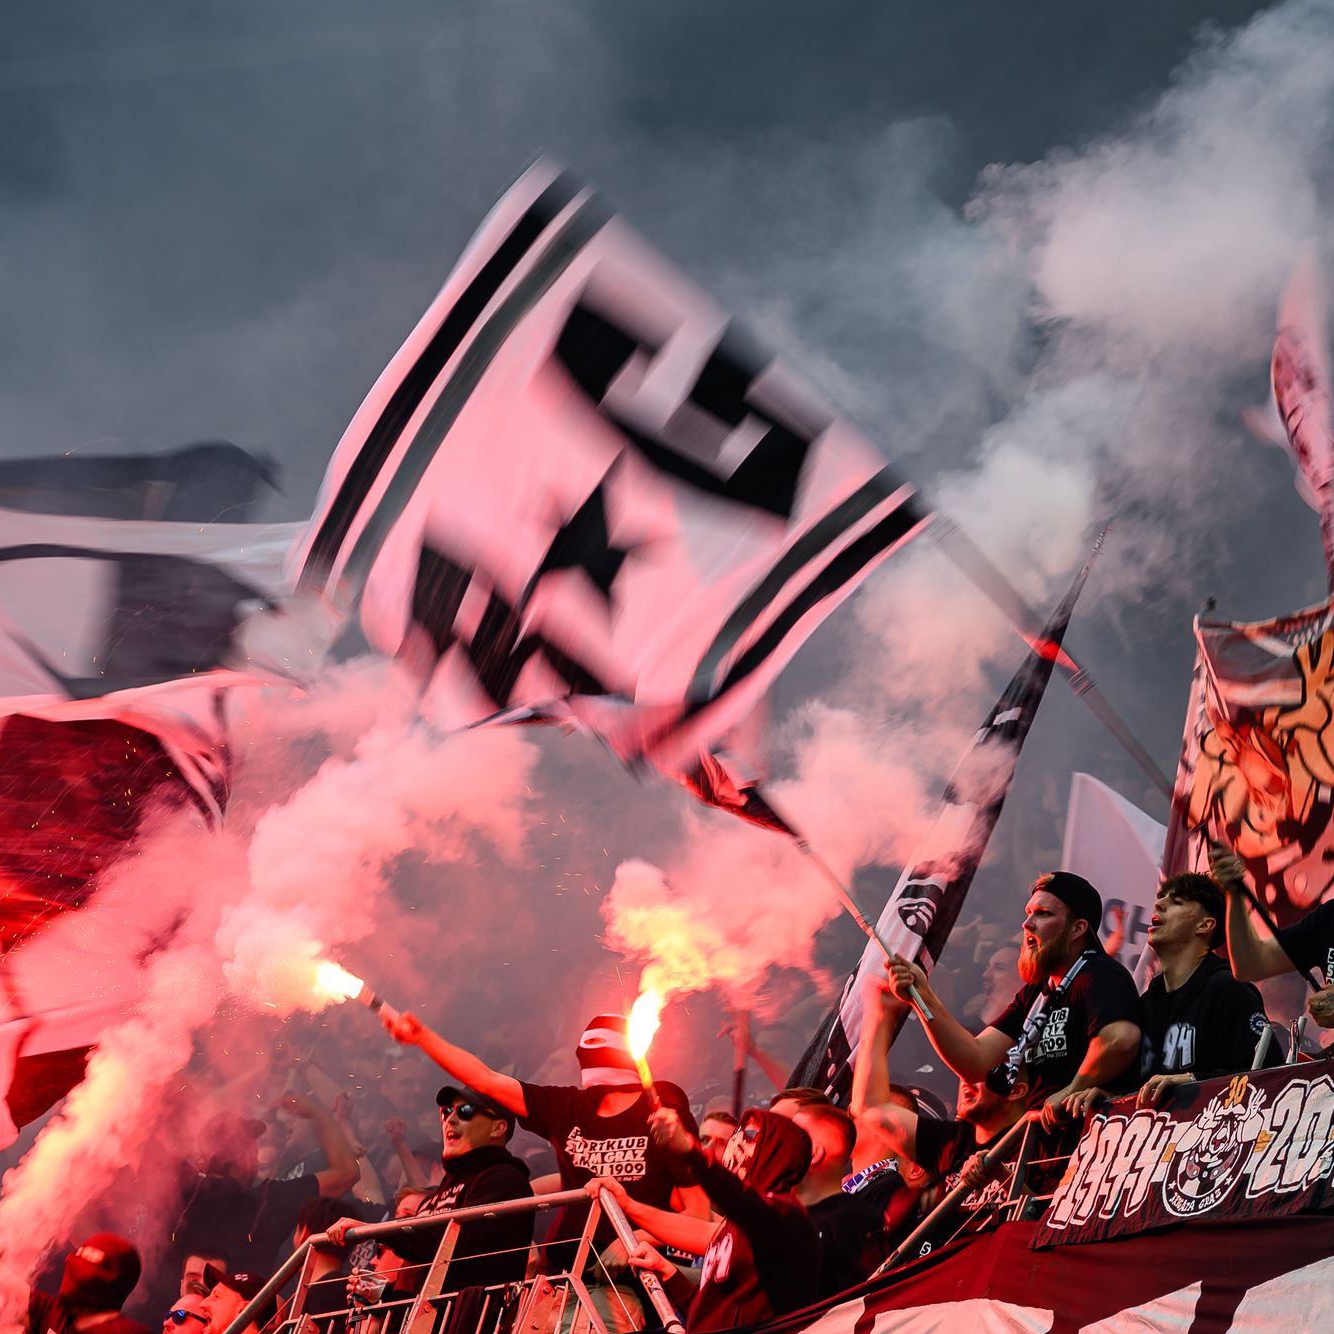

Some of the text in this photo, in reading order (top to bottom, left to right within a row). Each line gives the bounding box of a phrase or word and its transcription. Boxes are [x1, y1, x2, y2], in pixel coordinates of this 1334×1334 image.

[1043, 1023, 1066, 1039] RAZ
[1225, 1075, 1249, 1110] 30
[604, 1149, 646, 1164] GRAZ
[610, 1163, 644, 1176] 1909
[1048, 1109, 1184, 1229] 1994
